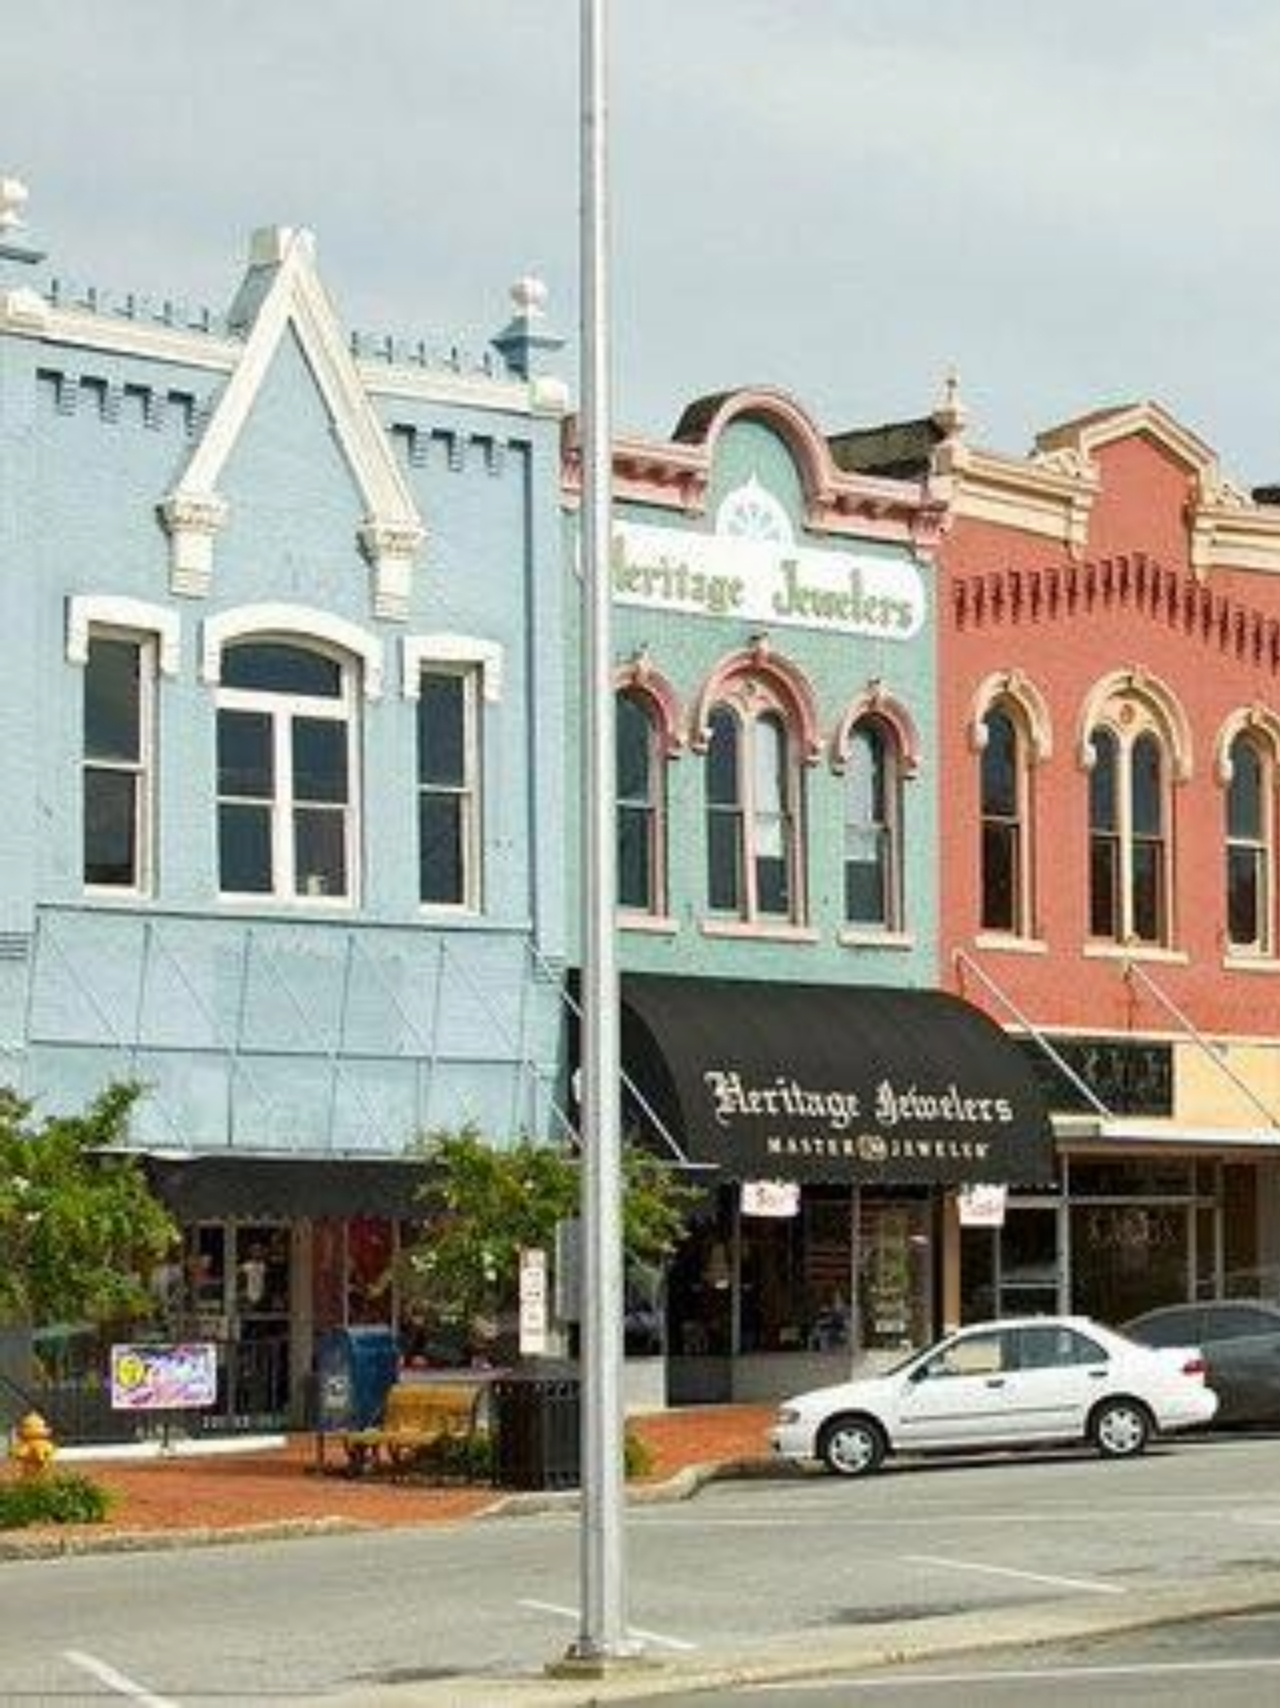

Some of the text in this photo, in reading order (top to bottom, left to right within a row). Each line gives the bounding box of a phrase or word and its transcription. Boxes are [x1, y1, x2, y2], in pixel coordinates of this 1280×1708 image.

[771, 559, 914, 629] Jewelers
[703, 1071, 1014, 1129] Heritage Jewelers
[767, 1135, 855, 1154] MASTER
